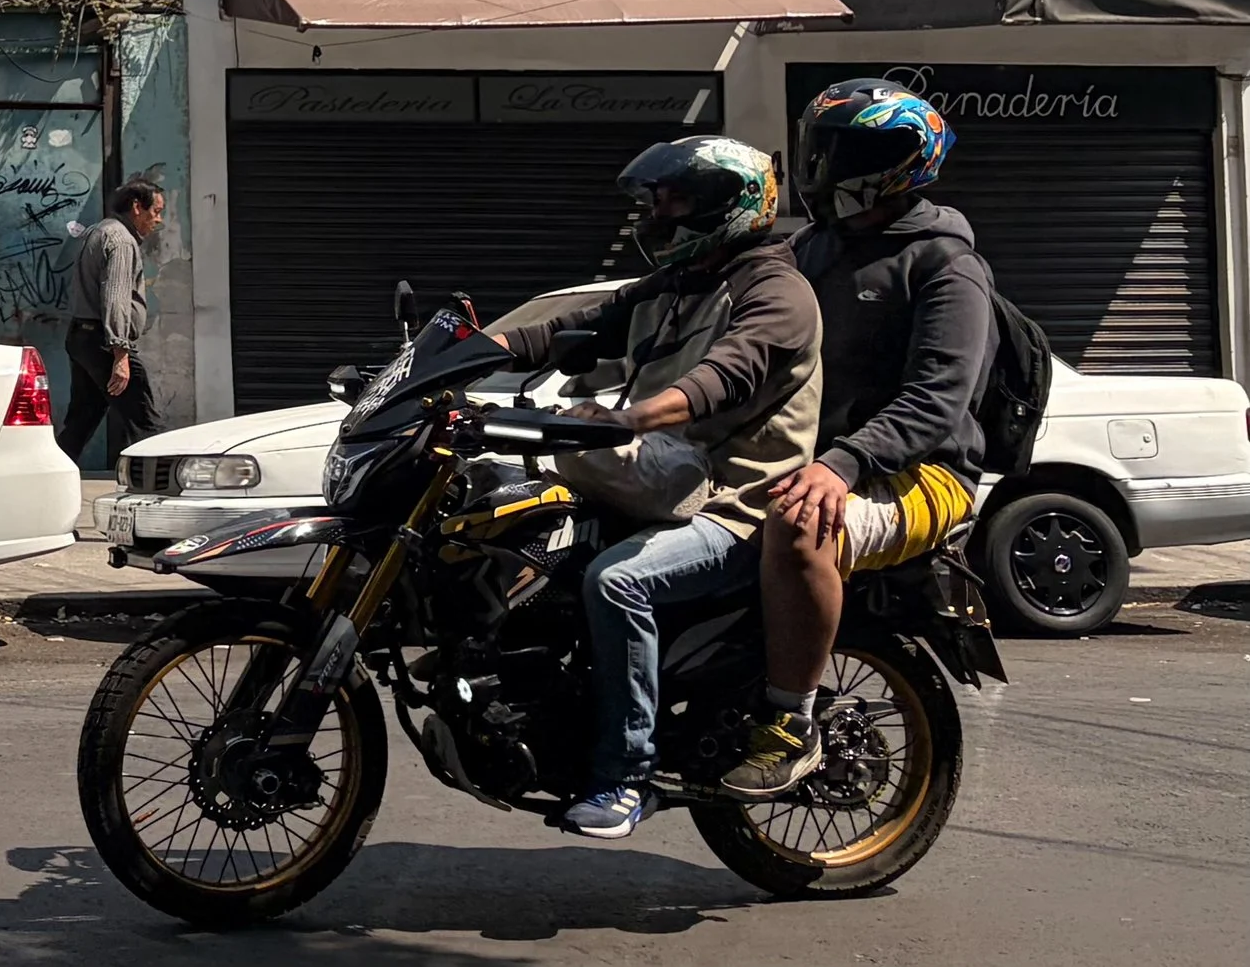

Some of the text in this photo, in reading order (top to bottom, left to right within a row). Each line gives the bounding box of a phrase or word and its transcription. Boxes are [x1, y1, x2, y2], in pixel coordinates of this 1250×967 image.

[501, 84, 561, 112] La
[562, 84, 690, 112] Carreta
[882, 66, 1119, 118] Panadería
